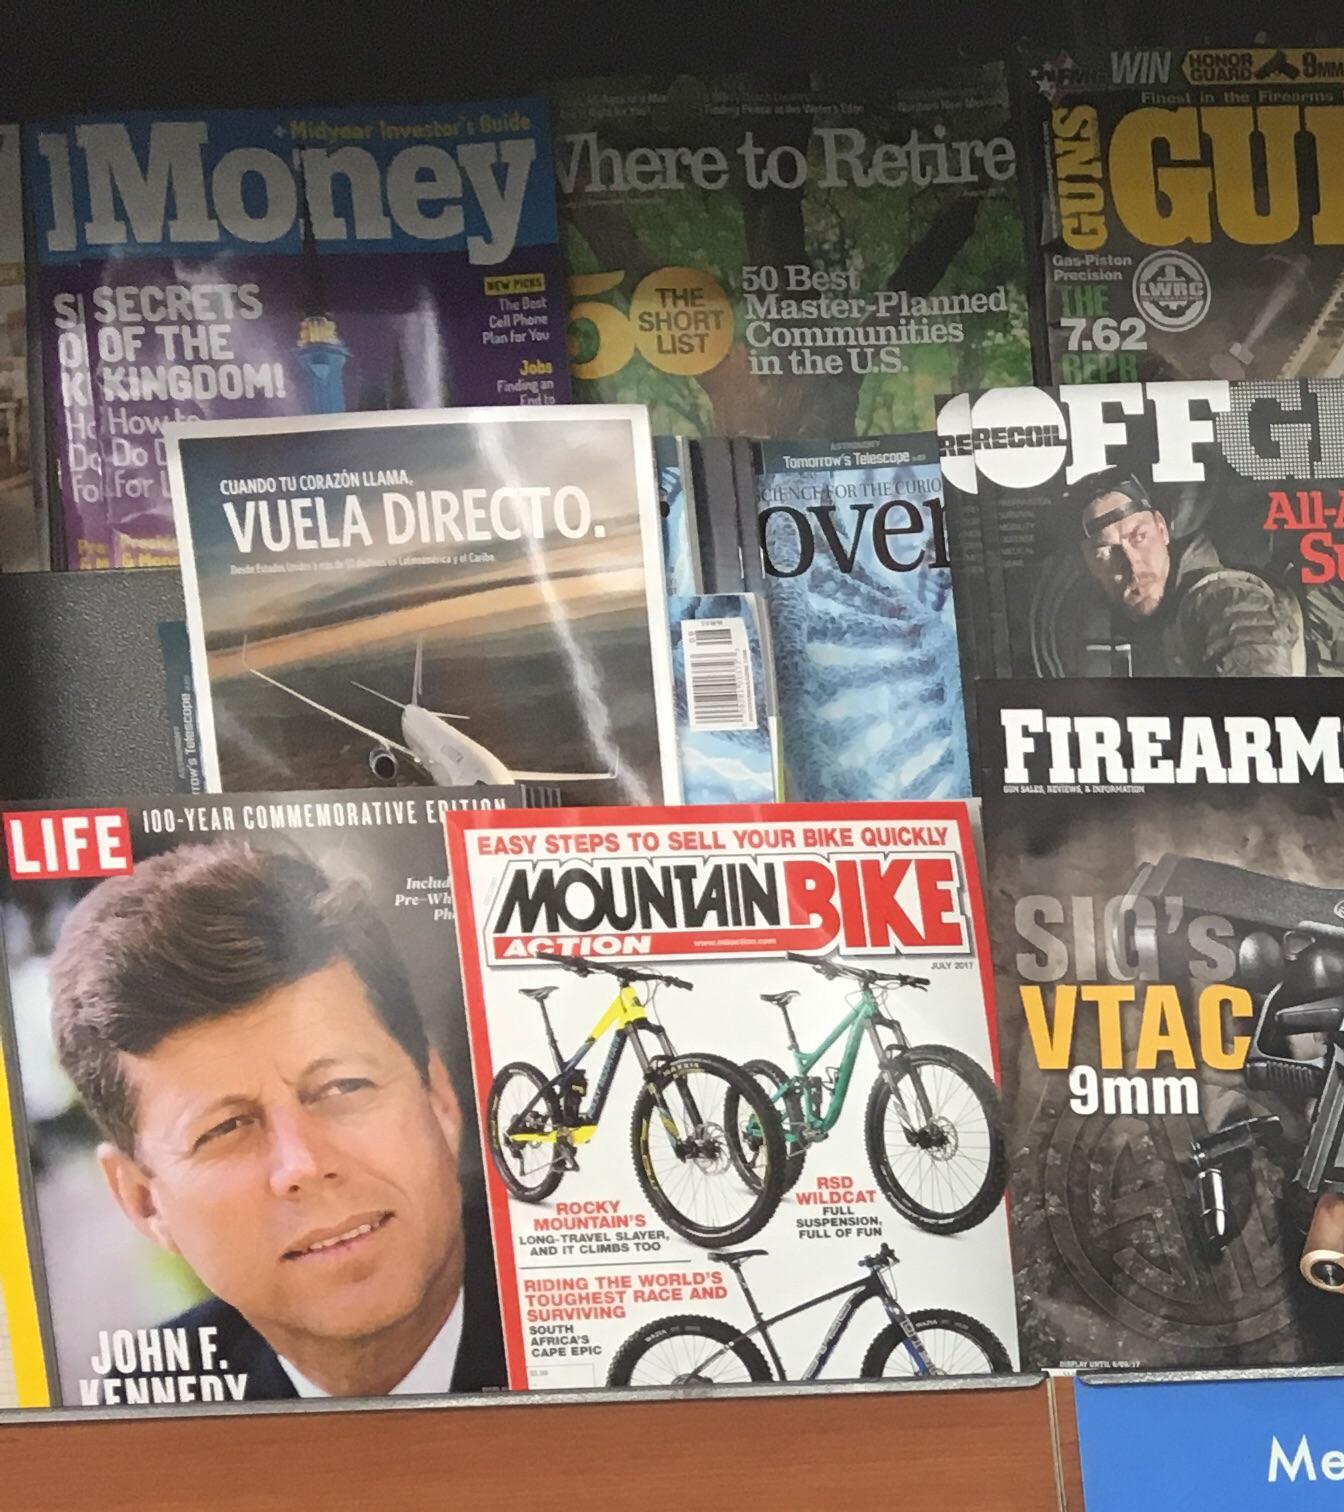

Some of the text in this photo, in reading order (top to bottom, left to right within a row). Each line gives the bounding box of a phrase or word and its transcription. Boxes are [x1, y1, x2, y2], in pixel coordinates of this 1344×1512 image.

[76, 121, 536, 266] Money
[654, 288, 705, 309] THE
[745, 288, 1011, 321] Master-Planned
[638, 308, 725, 333] SHORT
[747, 319, 965, 349] Communities
[1061, 317, 1148, 350] 7.62
[656, 332, 709, 354] LIST
[220, 470, 412, 495] CUANDO TU CORAZÓN LLAMA,
[224, 486, 606, 554] VUELA DIRECTO.
[9, 814, 128, 872] LIFE
[478, 827, 949, 854] EASY STEPS TO SELL YOUR BIKE QUICKLY
[494, 859, 963, 956] MOUNTAIN BIKE
[796, 1190, 876, 1204] WILDCAT
[816, 1176, 853, 1190] RSD
